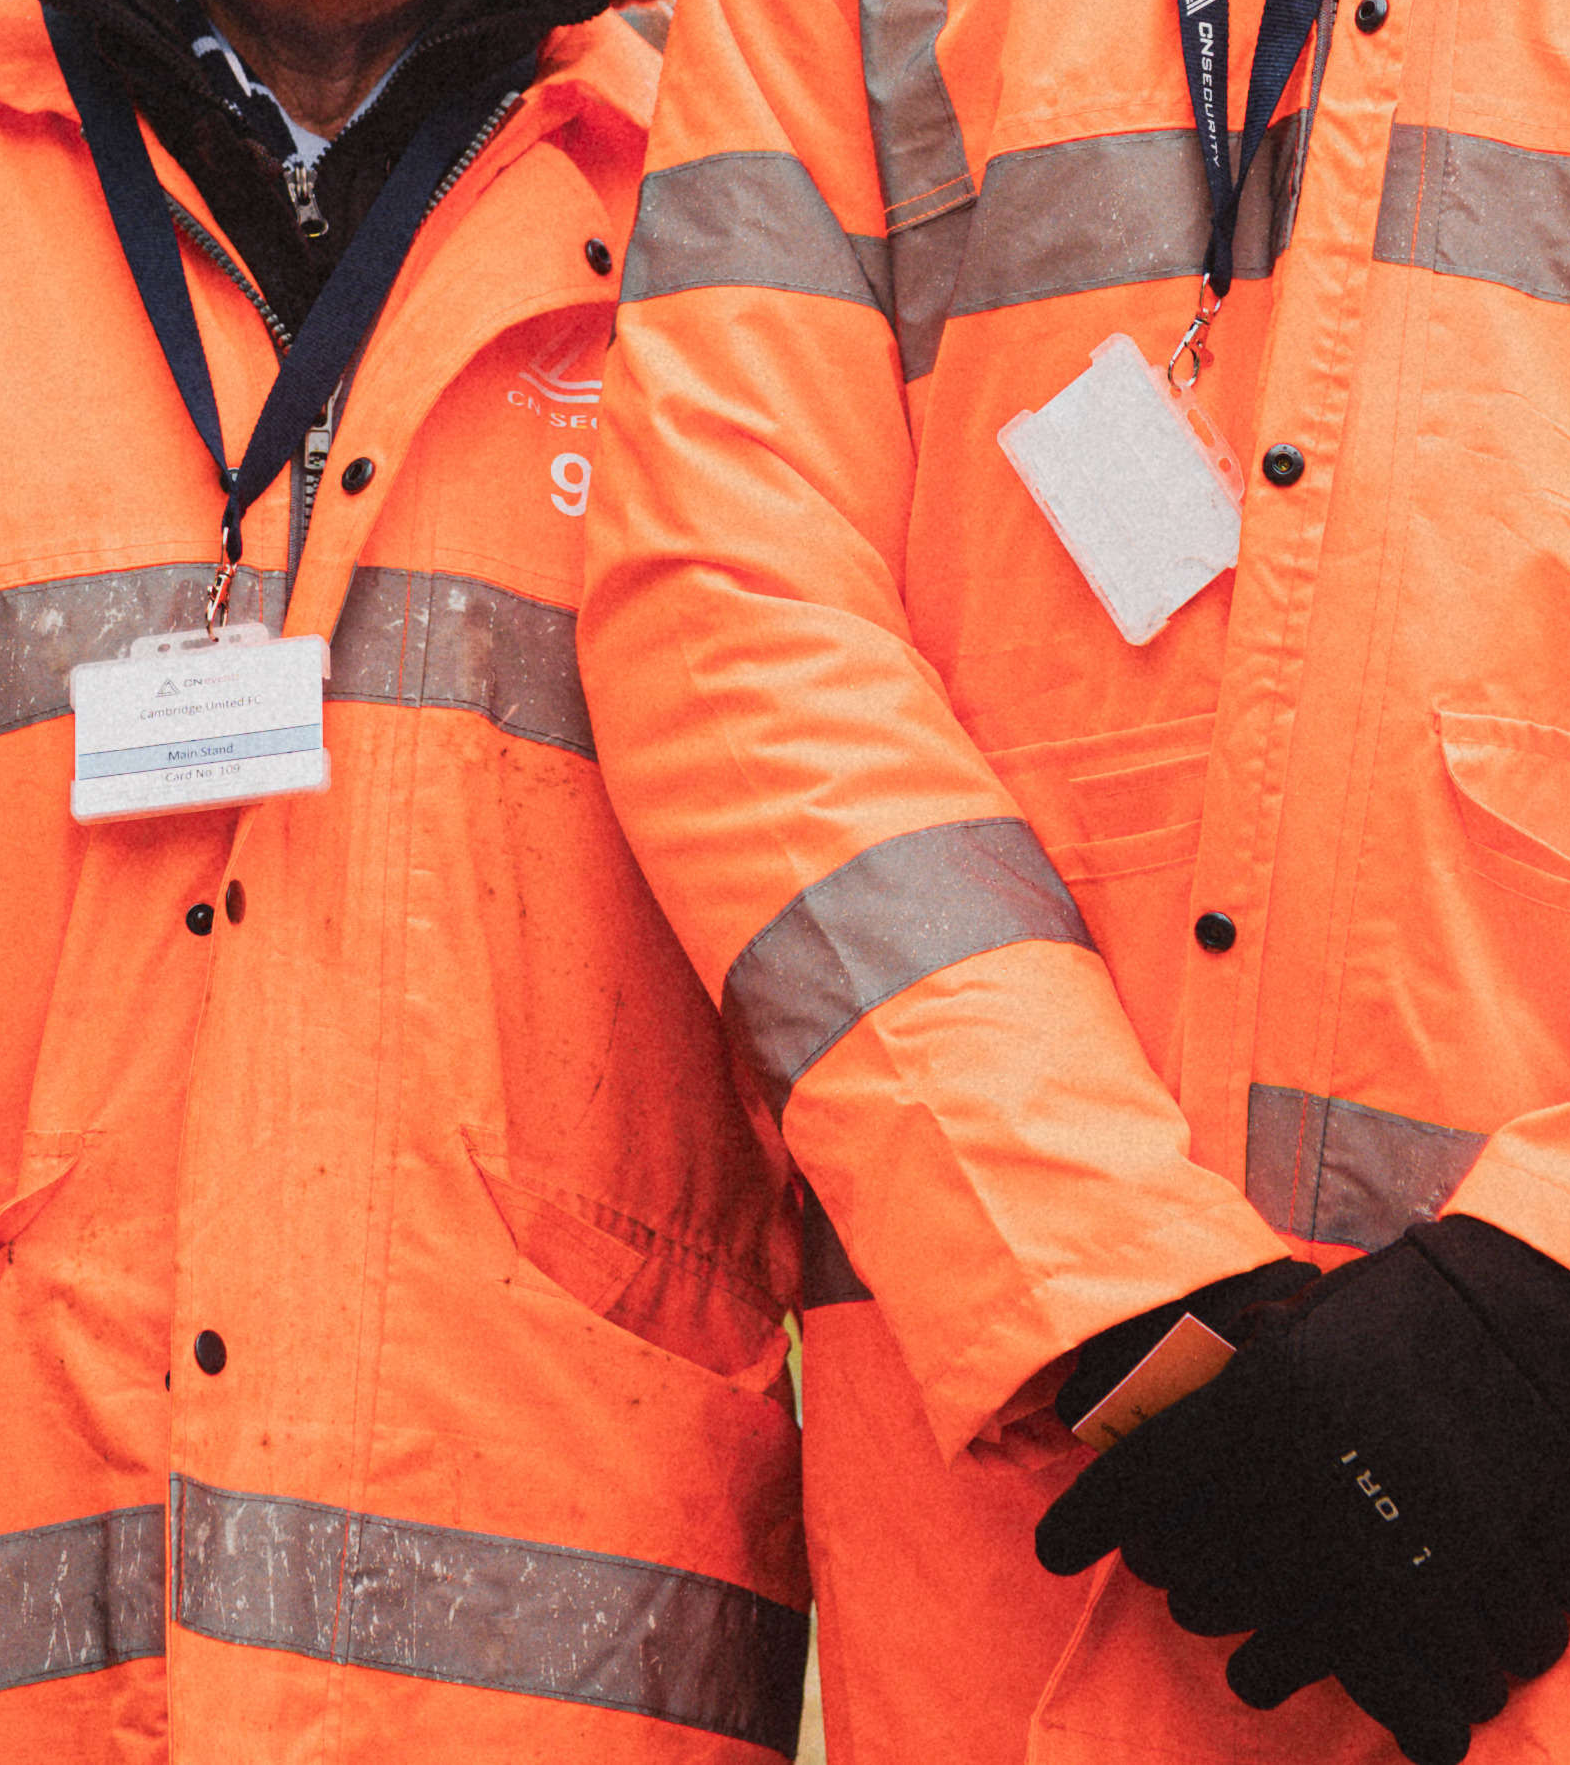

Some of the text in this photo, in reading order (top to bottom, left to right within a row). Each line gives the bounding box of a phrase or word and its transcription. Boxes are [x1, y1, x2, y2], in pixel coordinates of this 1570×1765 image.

[507, 390, 541, 416] CN
[140, 694, 262, 720] Cambridge United FC
[168, 743, 234, 761] Main Stand
[165, 763, 241, 782] Card No. 109
